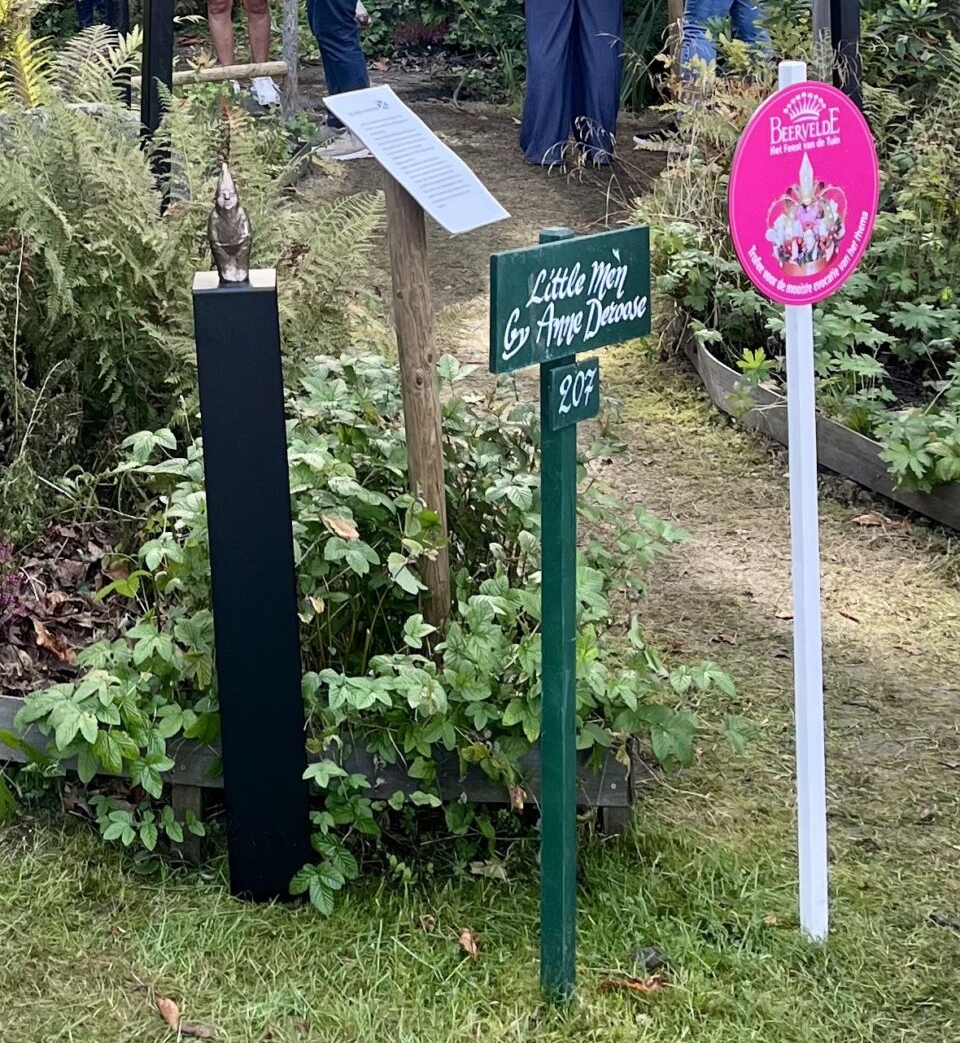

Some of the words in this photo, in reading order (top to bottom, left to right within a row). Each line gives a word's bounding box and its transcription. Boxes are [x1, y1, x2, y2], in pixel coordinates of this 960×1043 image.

[769, 107, 841, 145] BEERVELDE
[770, 145, 783, 156] Het
[783, 142, 803, 154] Feest
[803, 140, 816, 150] van
[816, 137, 826, 148] de
[825, 135, 841, 146] Tuin
[747, 244, 765, 274] Trofee
[762, 268, 779, 287] voor
[776, 277, 787, 292] de
[785, 282, 813, 296] mooiste
[837, 254, 851, 272] van
[846, 240, 859, 258] het
[853, 210, 869, 242] thema
[525, 261, 587, 308] Little
[535, 301, 584, 348] Anne
[583, 295, 648, 342] Deroose
[558, 368, 598, 414] 207
